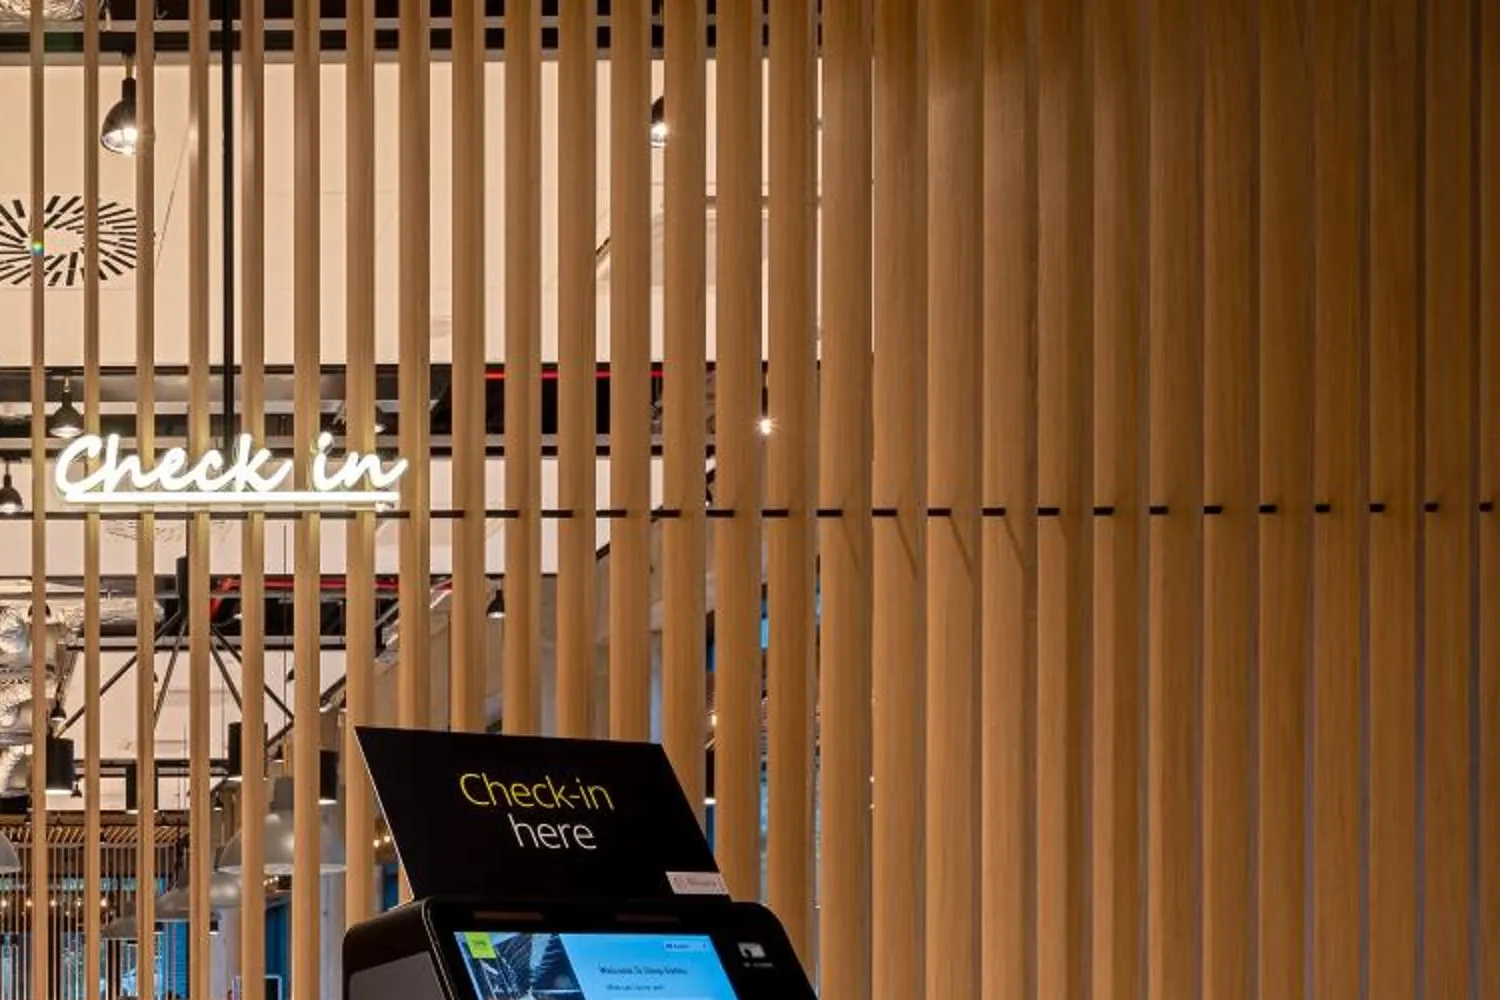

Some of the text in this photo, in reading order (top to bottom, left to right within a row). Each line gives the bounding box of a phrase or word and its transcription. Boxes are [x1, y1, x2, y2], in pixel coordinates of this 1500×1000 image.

[55, 432, 408, 494] Check in
[460, 772, 615, 811] Check-in
[508, 813, 597, 849] here
